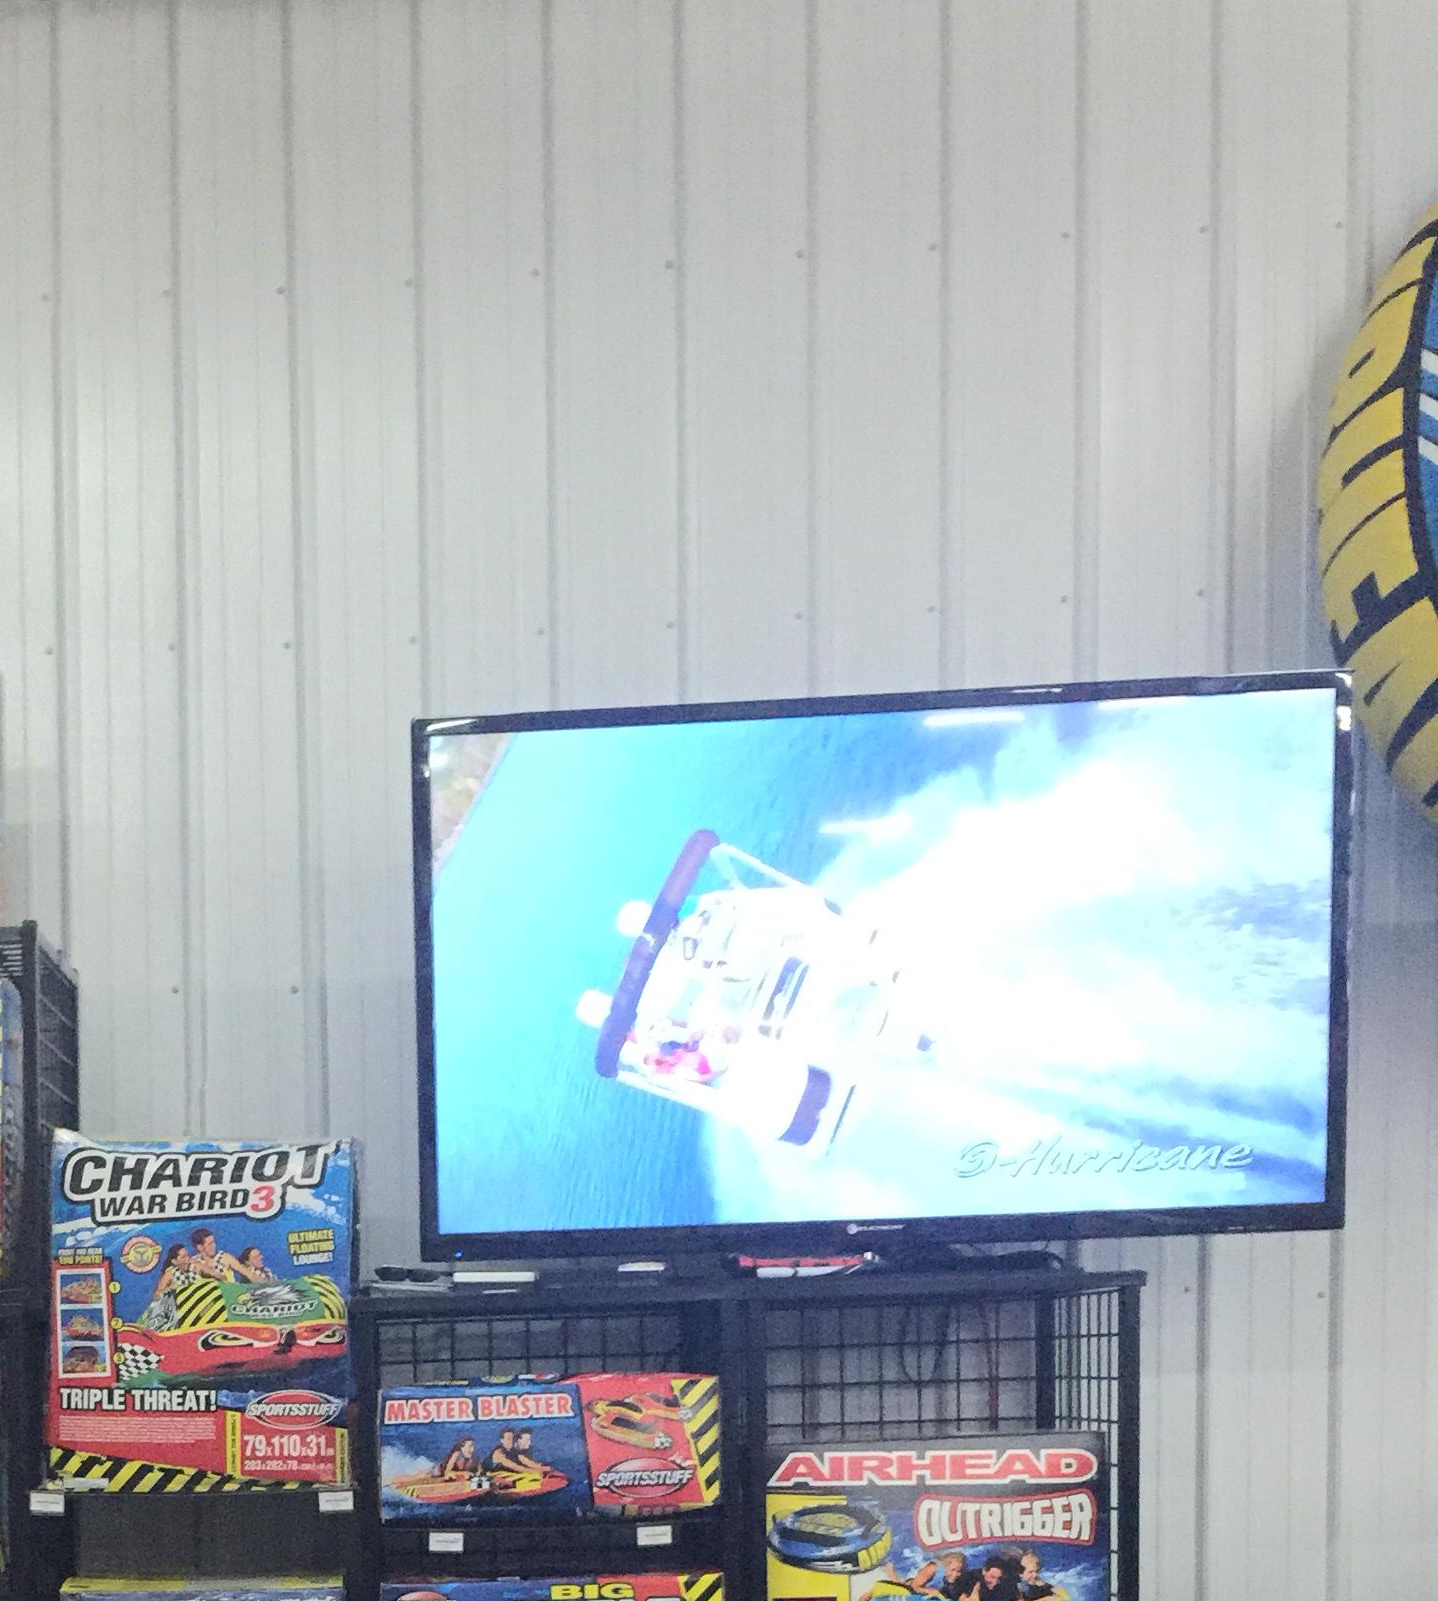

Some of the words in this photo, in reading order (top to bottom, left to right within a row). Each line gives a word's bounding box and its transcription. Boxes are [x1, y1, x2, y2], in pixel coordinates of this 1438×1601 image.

[63, 1138, 342, 1202] CHARIOT
[98, 1195, 170, 1222] WAR
[175, 1188, 250, 1213] BIRD
[59, 1388, 126, 1412] TRIPLE
[131, 1389, 218, 1412] THREAT!
[246, 1402, 343, 1418] SPORTSSTUFF
[384, 1397, 474, 1425] MASTER
[476, 1392, 575, 1421] BLASTER
[595, 1469, 694, 1487] SPORTSSTUFF
[767, 1448, 1099, 1488] AIRHEAD
[917, 1492, 1093, 1546] OUTRIGGER
[549, 1582, 636, 1600] BIG
